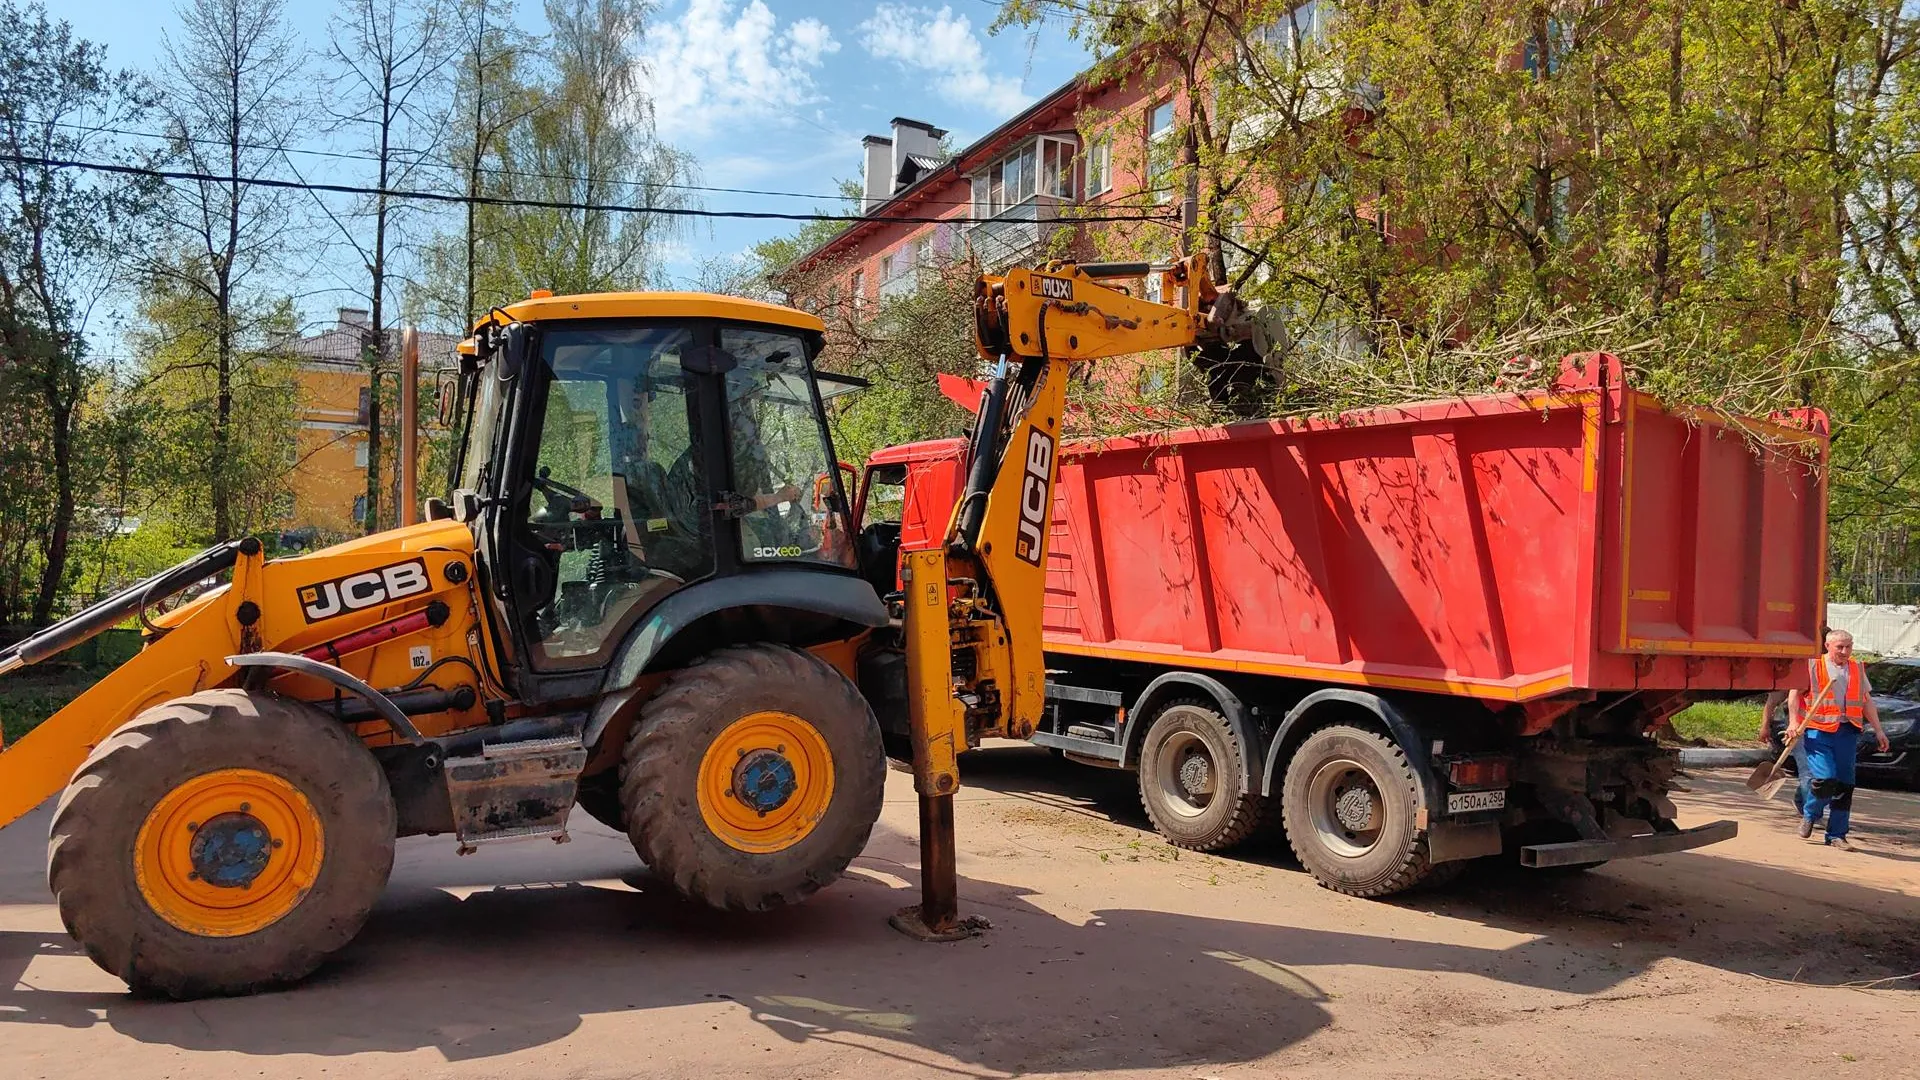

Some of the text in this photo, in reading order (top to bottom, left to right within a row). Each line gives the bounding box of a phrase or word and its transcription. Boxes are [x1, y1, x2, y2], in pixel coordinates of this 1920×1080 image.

[1020, 431, 1051, 562] JCB
[305, 561, 428, 619] JCB
[412, 655, 425, 668] 102
